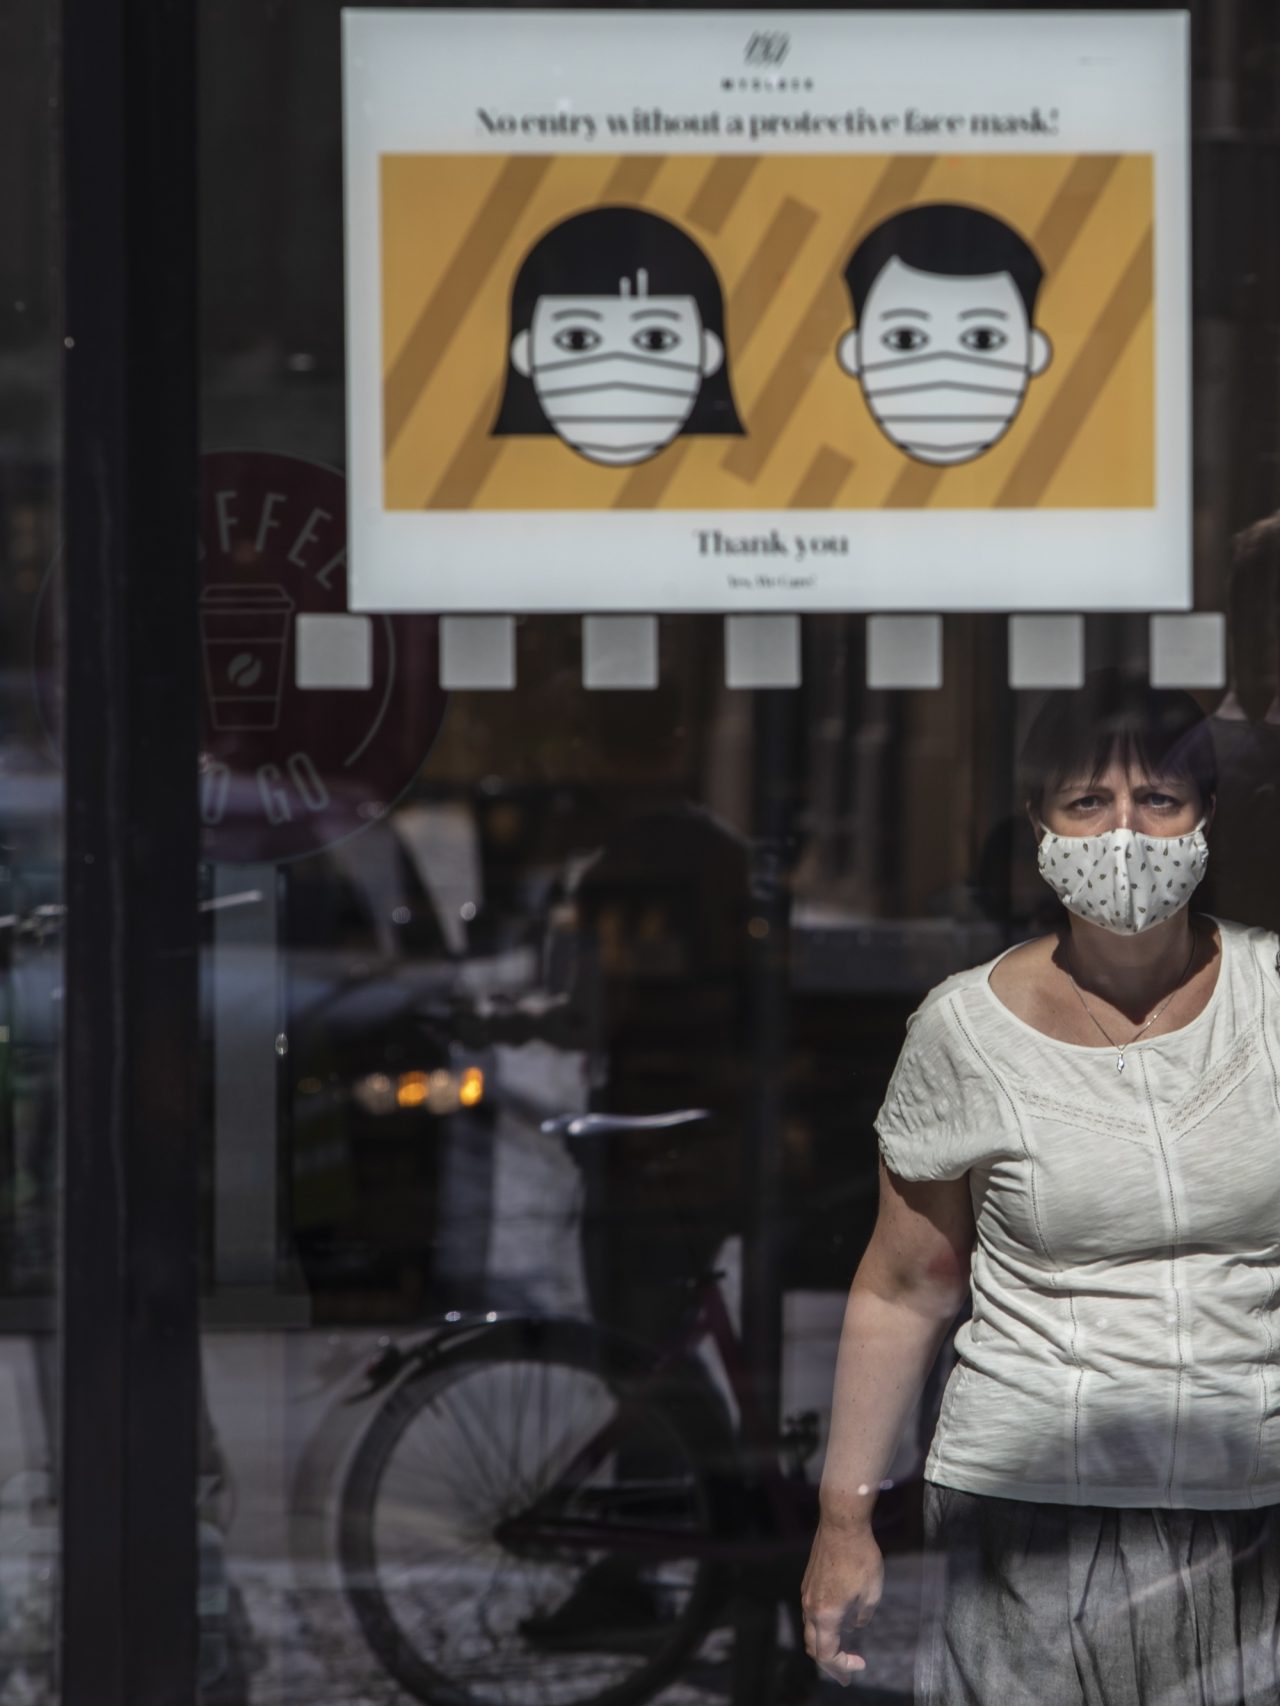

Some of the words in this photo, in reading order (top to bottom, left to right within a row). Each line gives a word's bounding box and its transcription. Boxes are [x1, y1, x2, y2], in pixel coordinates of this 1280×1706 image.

[475, 106, 517, 134] No
[520, 112, 597, 142] entry
[605, 105, 720, 136] without
[725, 114, 745, 135] a
[748, 107, 900, 141] protective
[904, 107, 965, 135] face
[969, 106, 1060, 135] mask!
[692, 528, 788, 556] Thank
[794, 535, 849, 562] you
[256, 751, 331, 827] GO
